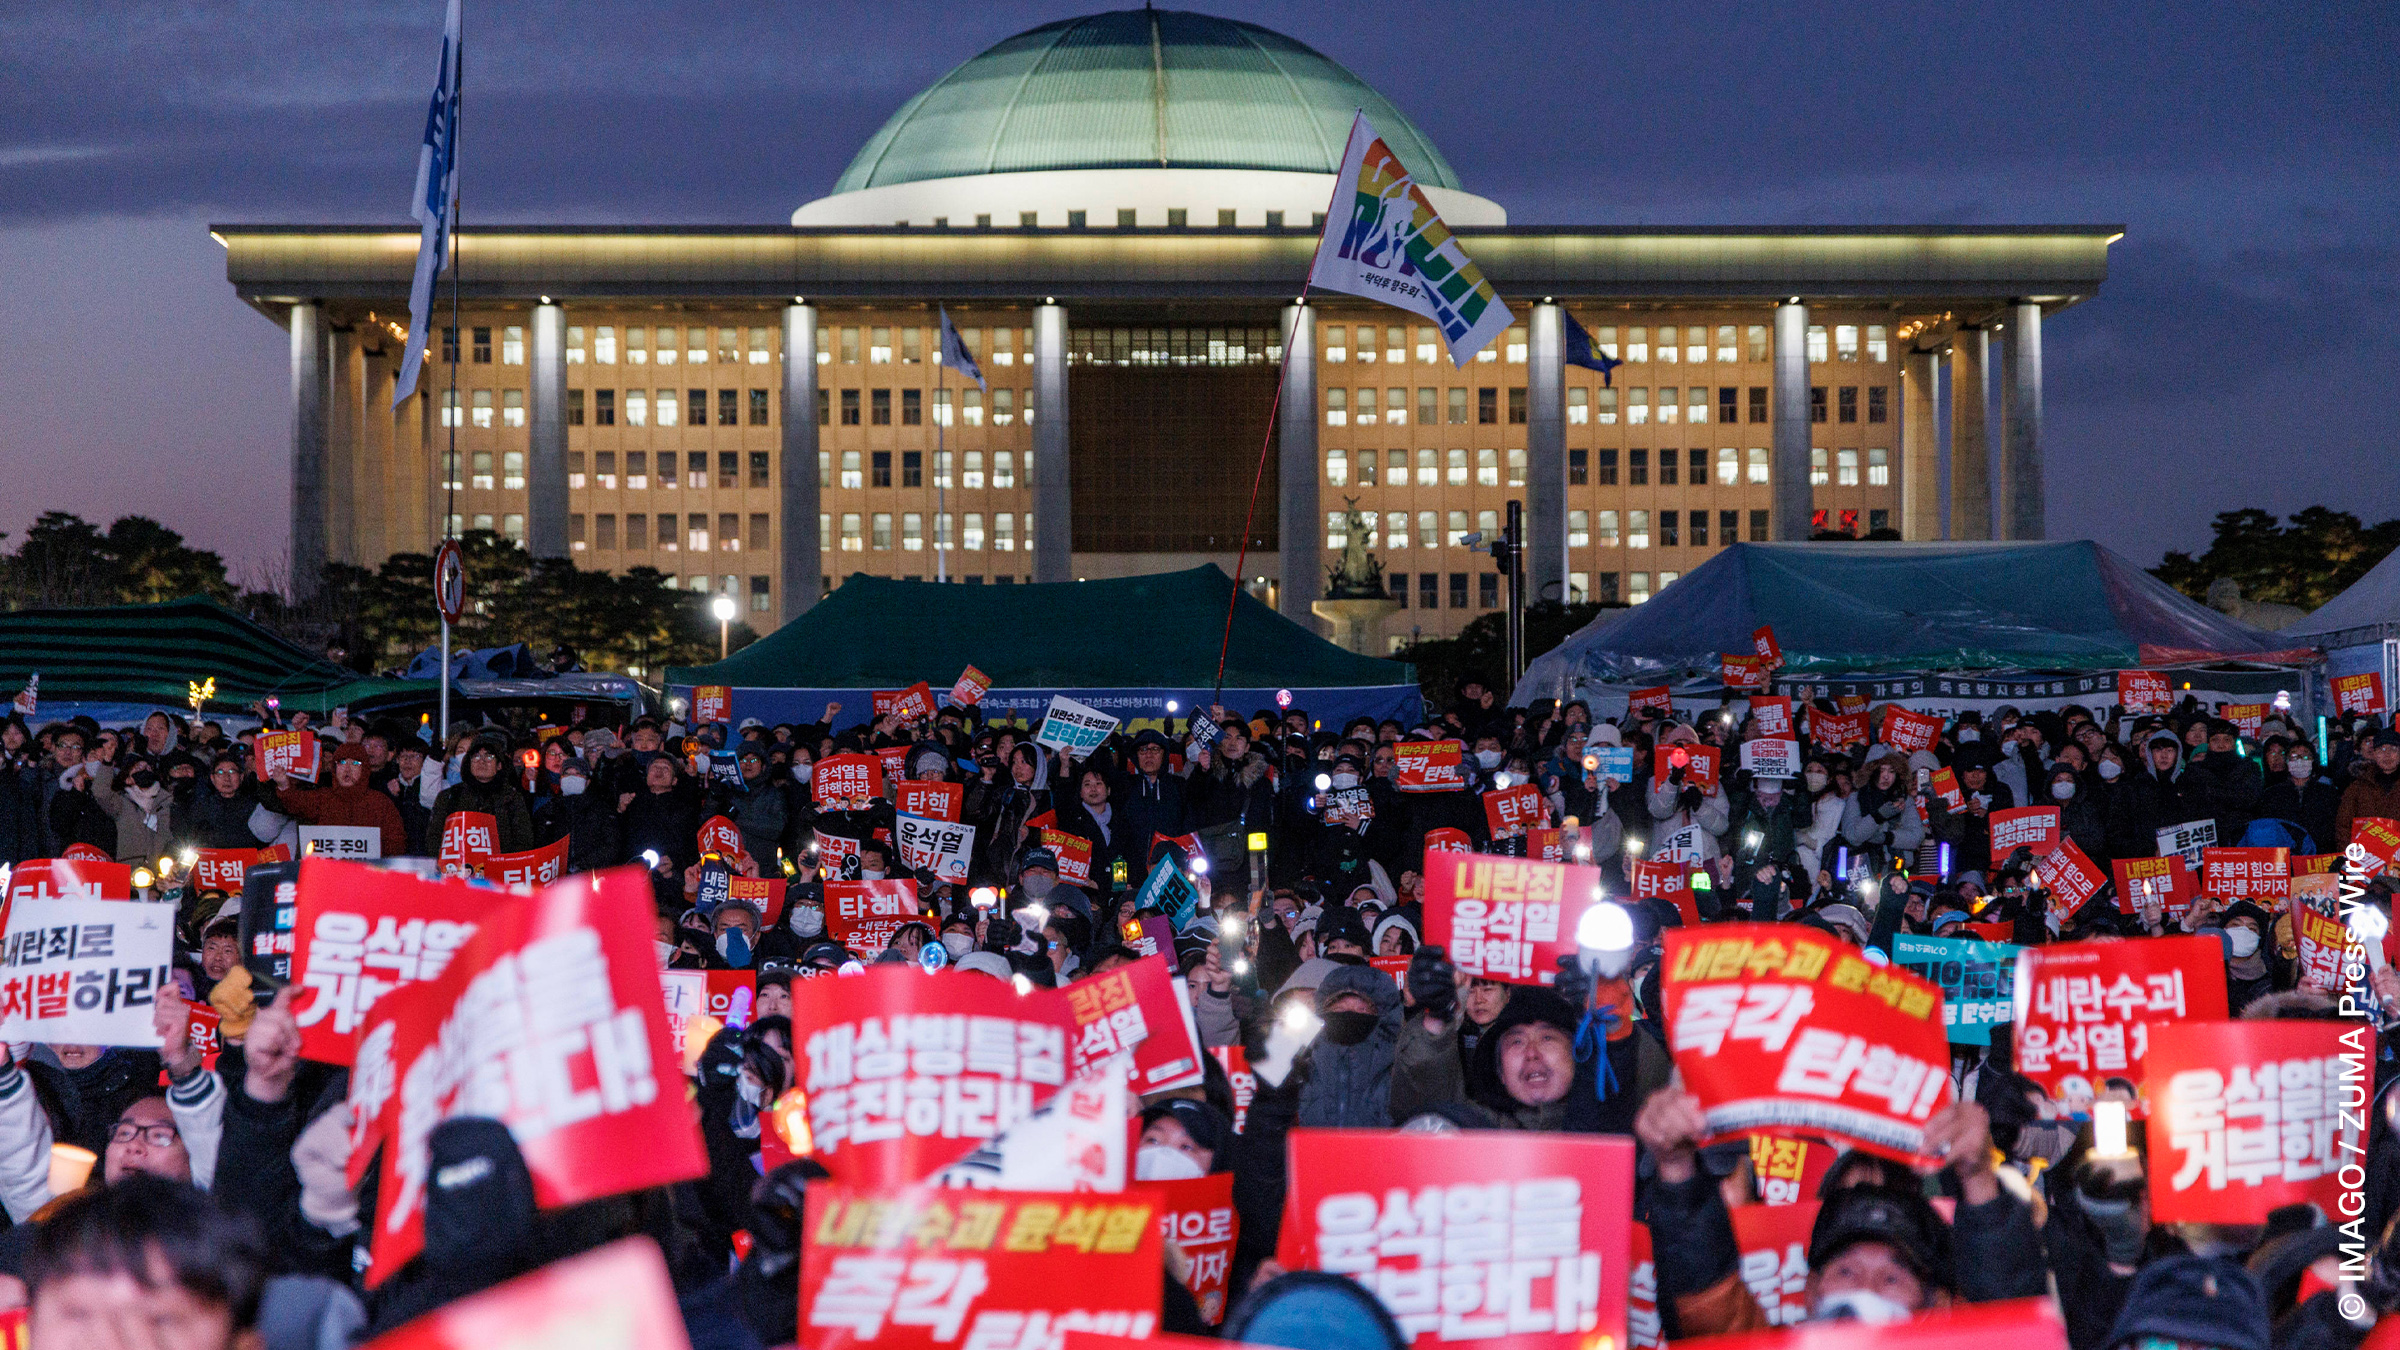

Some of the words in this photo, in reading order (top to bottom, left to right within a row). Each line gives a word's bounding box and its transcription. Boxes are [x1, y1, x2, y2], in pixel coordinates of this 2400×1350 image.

[1756, 635, 1772, 658] 핵
[1874, 681, 1924, 695] 가족의
[2338, 674, 2371, 692] 내란죄
[2340, 687, 2374, 704] 윤석열
[979, 696, 1039, 709] 금속노동조합
[1040, 719, 1110, 747] 탄핵하라
[1049, 707, 1084, 725] 내란수괴
[1084, 714, 1116, 731] 윤석열을
[1894, 716, 1935, 733] 윤석열을
[262, 732, 301, 751] 내란죄
[1395, 744, 1431, 756] 내란수괴
[1431, 743, 1459, 754] 윤석열
[1891, 730, 1930, 750] 탄핵하라
[819, 764, 870, 783] 윤석열을
[1397, 756, 1429, 774] 즉각
[818, 780, 871, 798] 탄핵하라
[907, 791, 950, 818] 탄핵
[1497, 793, 1539, 823] 탄핵
[340, 838, 368, 854] 주의
[440, 826, 492, 860] 탄핵
[703, 825, 740, 853] 탄핵
[900, 821, 964, 854] 윤석열
[2175, 822, 2215, 851] 윤석열
[503, 855, 560, 889] 탄핵
[820, 850, 842, 868] 석열
[2125, 857, 2171, 879] 내란죄
[2209, 862, 2248, 878] 촛불의
[2250, 861, 2288, 877] 힘으로
[198, 860, 245, 888] 탄핵
[1455, 862, 1566, 904] 내란죄
[1637, 874, 1685, 898] 탄핵
[2066, 861, 2095, 897] 힘으로
[2208, 879, 2249, 896] 나라를
[2250, 879, 2289, 895] 지키자
[2054, 876, 2083, 909] 지키자
[839, 894, 899, 920] 탄핵
[1451, 899, 1561, 943] 윤석열
[858, 919, 922, 931] 내란수
[306, 911, 480, 982] 윤석열
[846, 931, 895, 948] 윤석열
[1450, 939, 1534, 979] 탄핵!
[1672, 937, 1833, 984] 내란수괴
[1830, 955, 1936, 1022] 윤석열
[1067, 970, 1136, 1026] 란죄
[2036, 967, 2186, 1025] 내란수괴
[1671, 983, 1813, 1056] 즉각
[1962, 1001, 2015, 1025] 란수괴
[806, 1013, 1066, 1092] 채상병특검
[2021, 1022, 2127, 1074] 윤석열
[1776, 1028, 1946, 1120] 탄핵!
[815, 1200, 1006, 1250] 내란수괴
[1004, 1204, 1153, 1253] 윤석열
[1314, 1175, 1582, 1274] 윤석열을
[810, 1256, 990, 1343] 즉각
[1358, 1251, 1602, 1346] 부한다!
